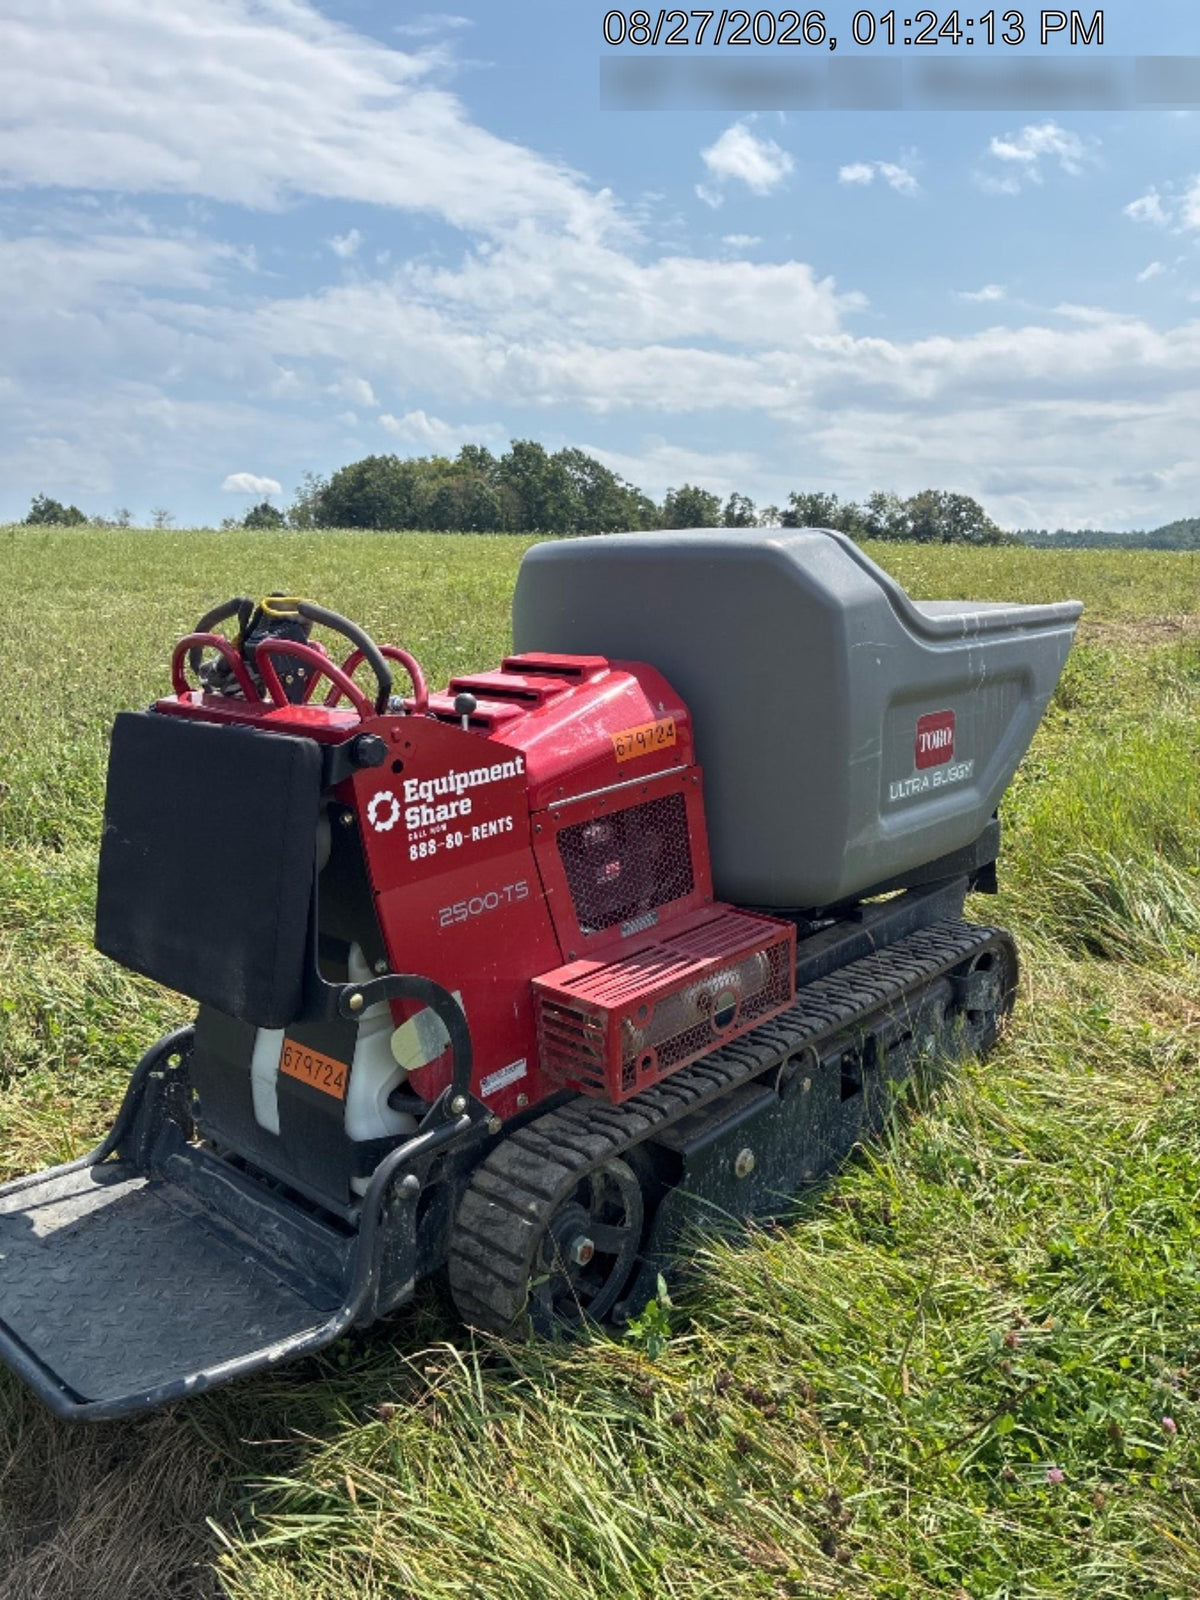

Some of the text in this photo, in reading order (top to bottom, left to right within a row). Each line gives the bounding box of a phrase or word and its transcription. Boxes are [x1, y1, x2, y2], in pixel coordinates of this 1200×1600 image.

[615, 723, 675, 757] 679724
[919, 726, 952, 753] TORO
[403, 755, 525, 802] Equipment
[889, 759, 974, 800] ULTRA BUGGY
[404, 797, 472, 830] Share
[409, 815, 513, 861] 888-80-RENTS
[439, 881, 529, 927] 2500-TS
[283, 1046, 345, 1088] 679724
